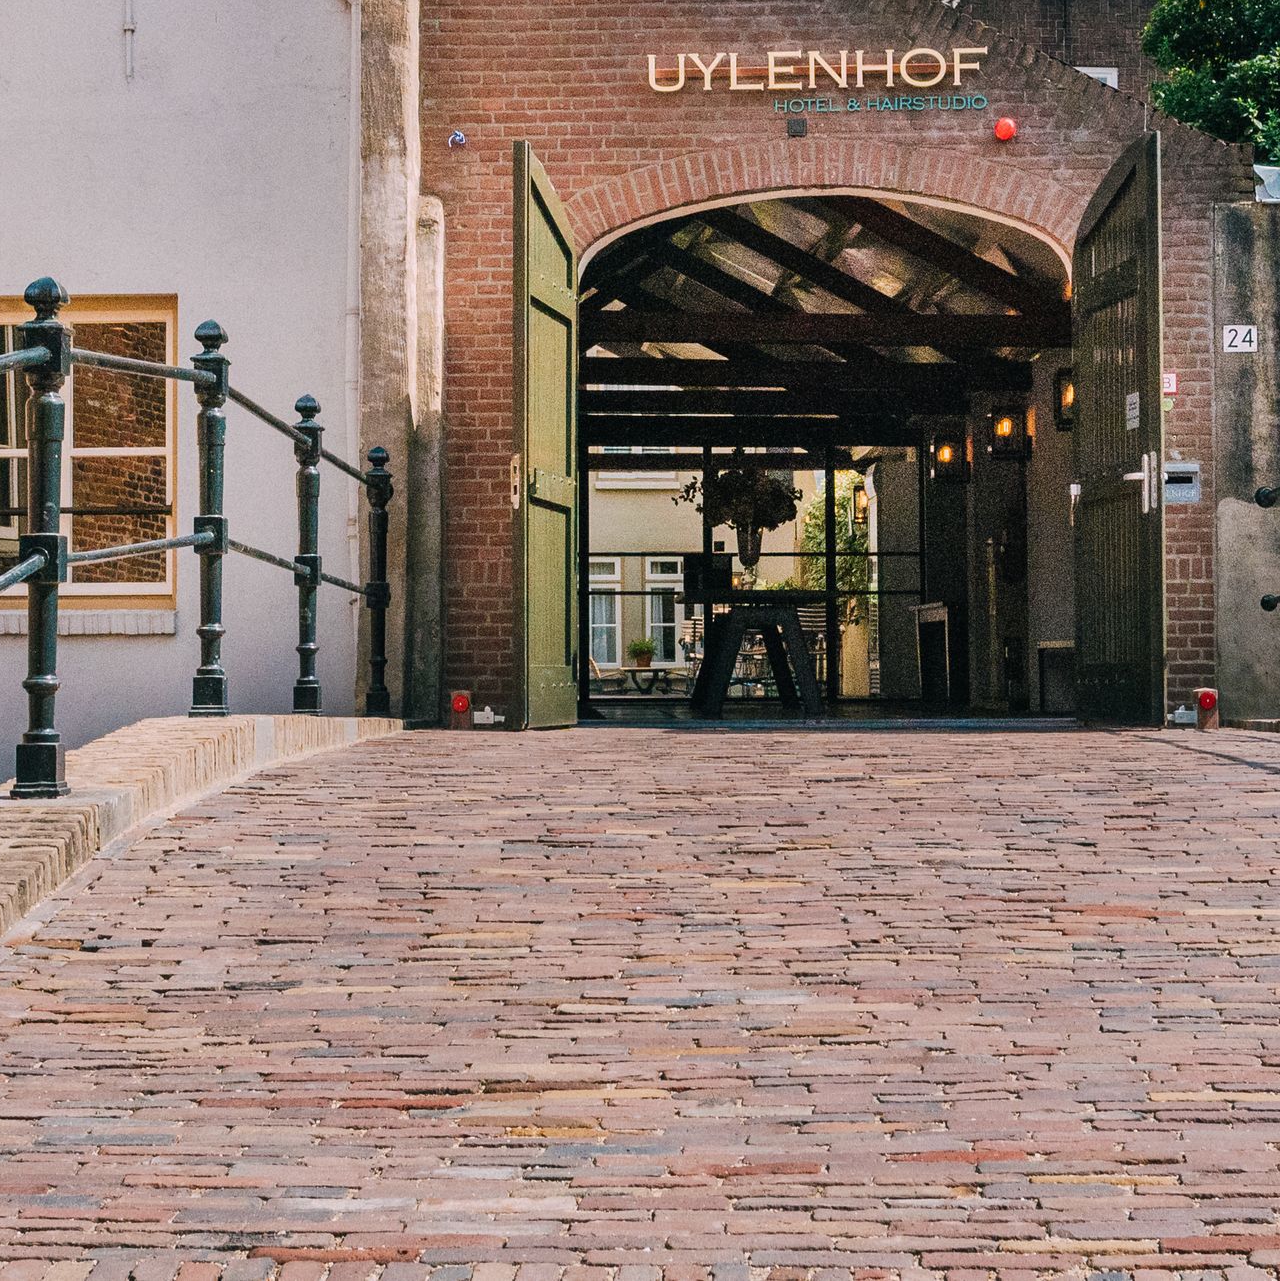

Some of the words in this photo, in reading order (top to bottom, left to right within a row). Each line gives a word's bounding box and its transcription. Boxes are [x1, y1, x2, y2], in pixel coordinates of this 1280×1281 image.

[647, 46, 988, 92] UYLENHOF
[774, 98, 841, 113] HOTEL
[847, 98, 860, 112] &
[867, 94, 989, 111] HAIRSTUDIO
[1228, 328, 1254, 348] 24
